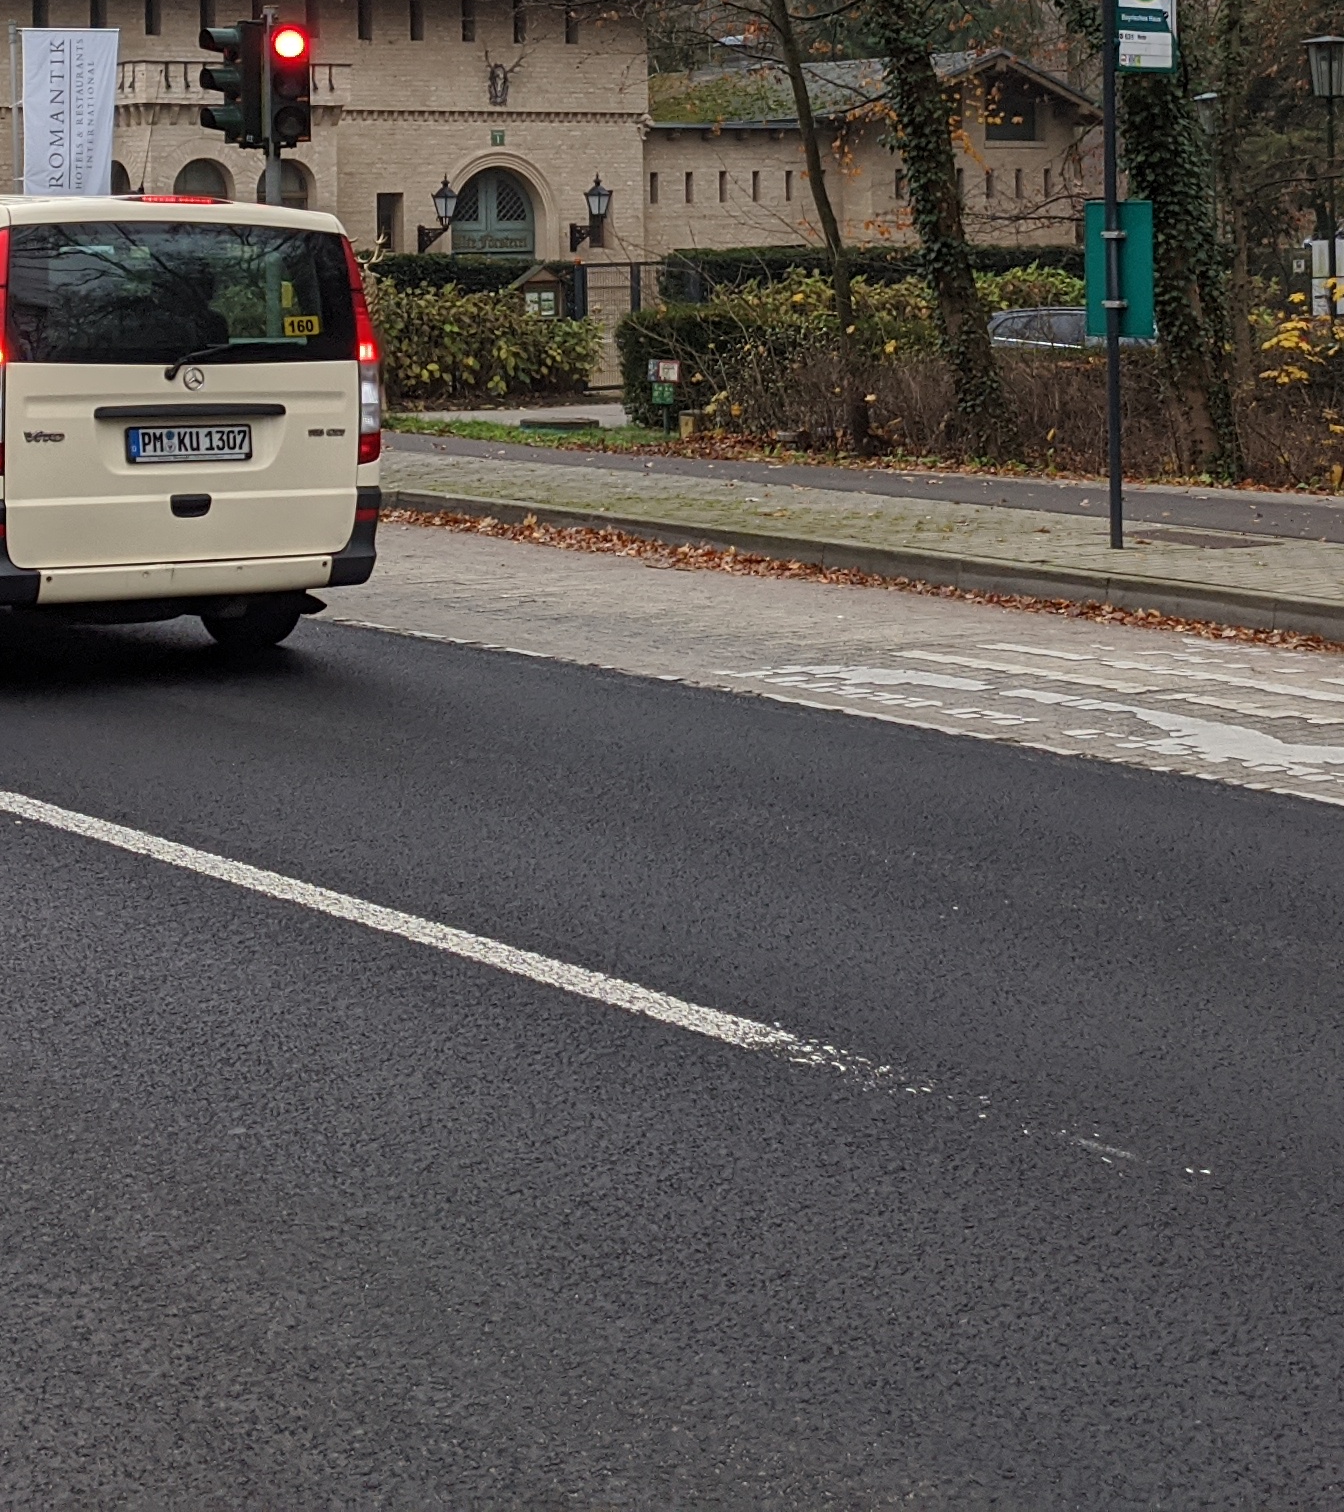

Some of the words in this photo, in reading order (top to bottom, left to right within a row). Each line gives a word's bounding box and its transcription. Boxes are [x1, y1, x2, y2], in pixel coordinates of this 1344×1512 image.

[48, 39, 65, 189] ROMANTIK
[75, 38, 84, 126] RESTAURANTS
[86, 61, 95, 169] INTERNATIONAL
[75, 143, 84, 189] HOTELS
[289, 319, 314, 333] 160
[141, 431, 164, 453] PM
[177, 431, 201, 452] KU
[204, 430, 247, 451] 1307
